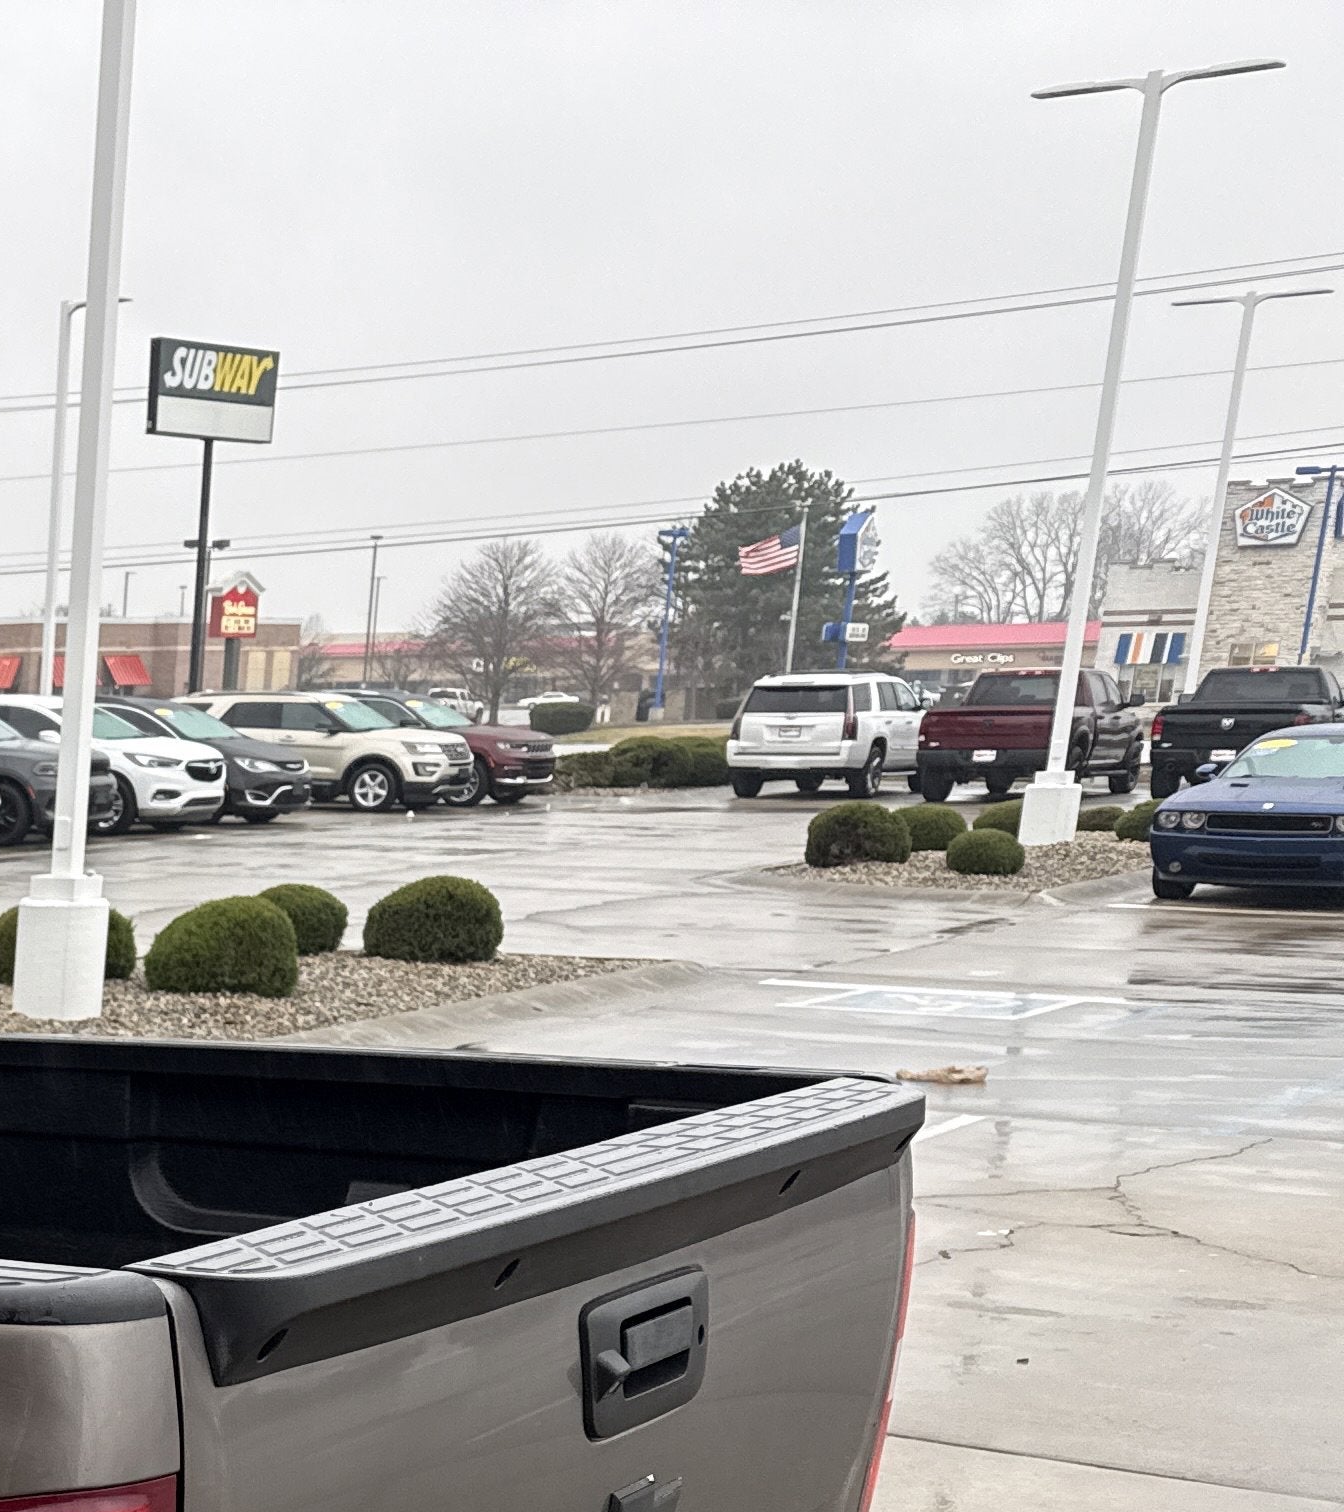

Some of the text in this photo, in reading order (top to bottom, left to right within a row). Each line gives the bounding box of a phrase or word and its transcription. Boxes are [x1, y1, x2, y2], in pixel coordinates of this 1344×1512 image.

[163, 346, 274, 395] SUBWAY
[1248, 506, 1297, 523] White
[1243, 520, 1297, 534] Castle
[950, 652, 1014, 664] Great Clips
